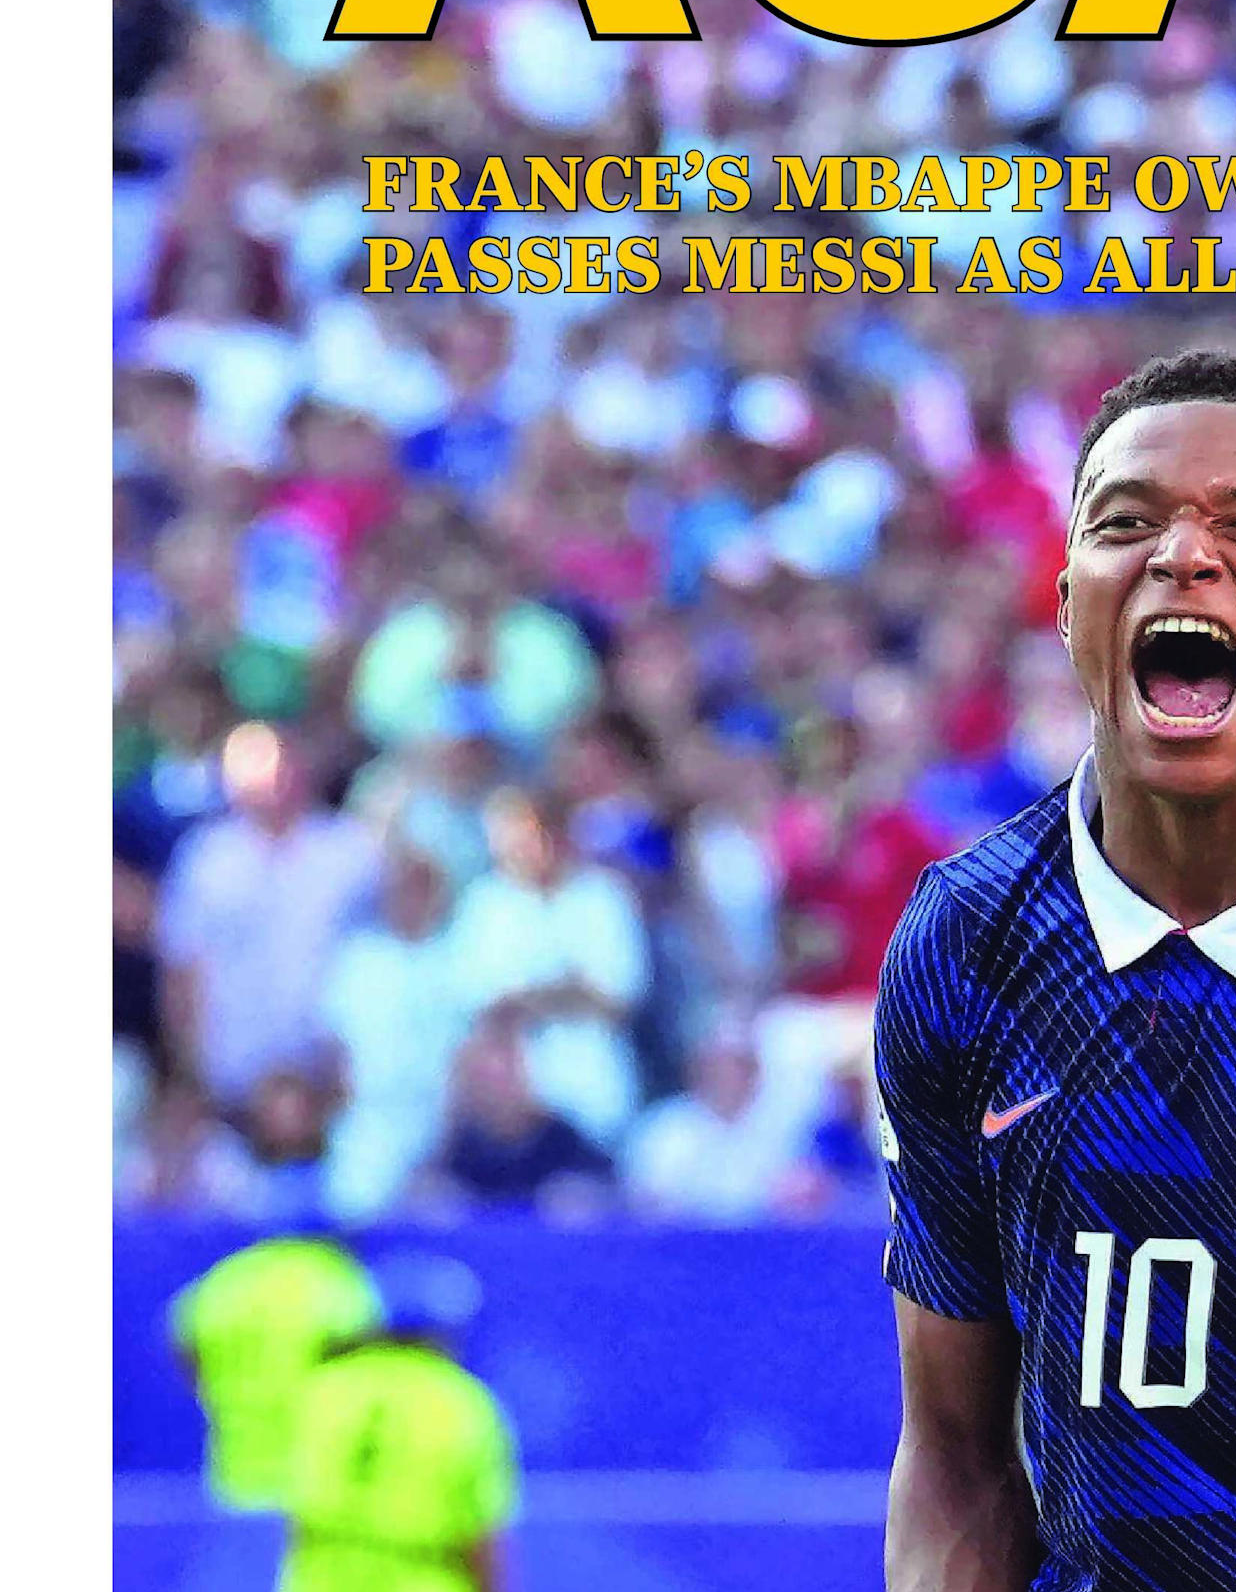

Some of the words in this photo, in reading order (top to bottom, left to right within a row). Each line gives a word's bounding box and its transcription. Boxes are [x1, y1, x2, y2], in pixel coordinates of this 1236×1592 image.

[364, 149, 751, 212] FRANCE’S
[774, 155, 1110, 212] MBAPPE
[363, 236, 661, 294] PASSES
[683, 236, 937, 294] MESSI
[957, 236, 1064, 294] AS
[1074, 1231, 1218, 1411] 10
